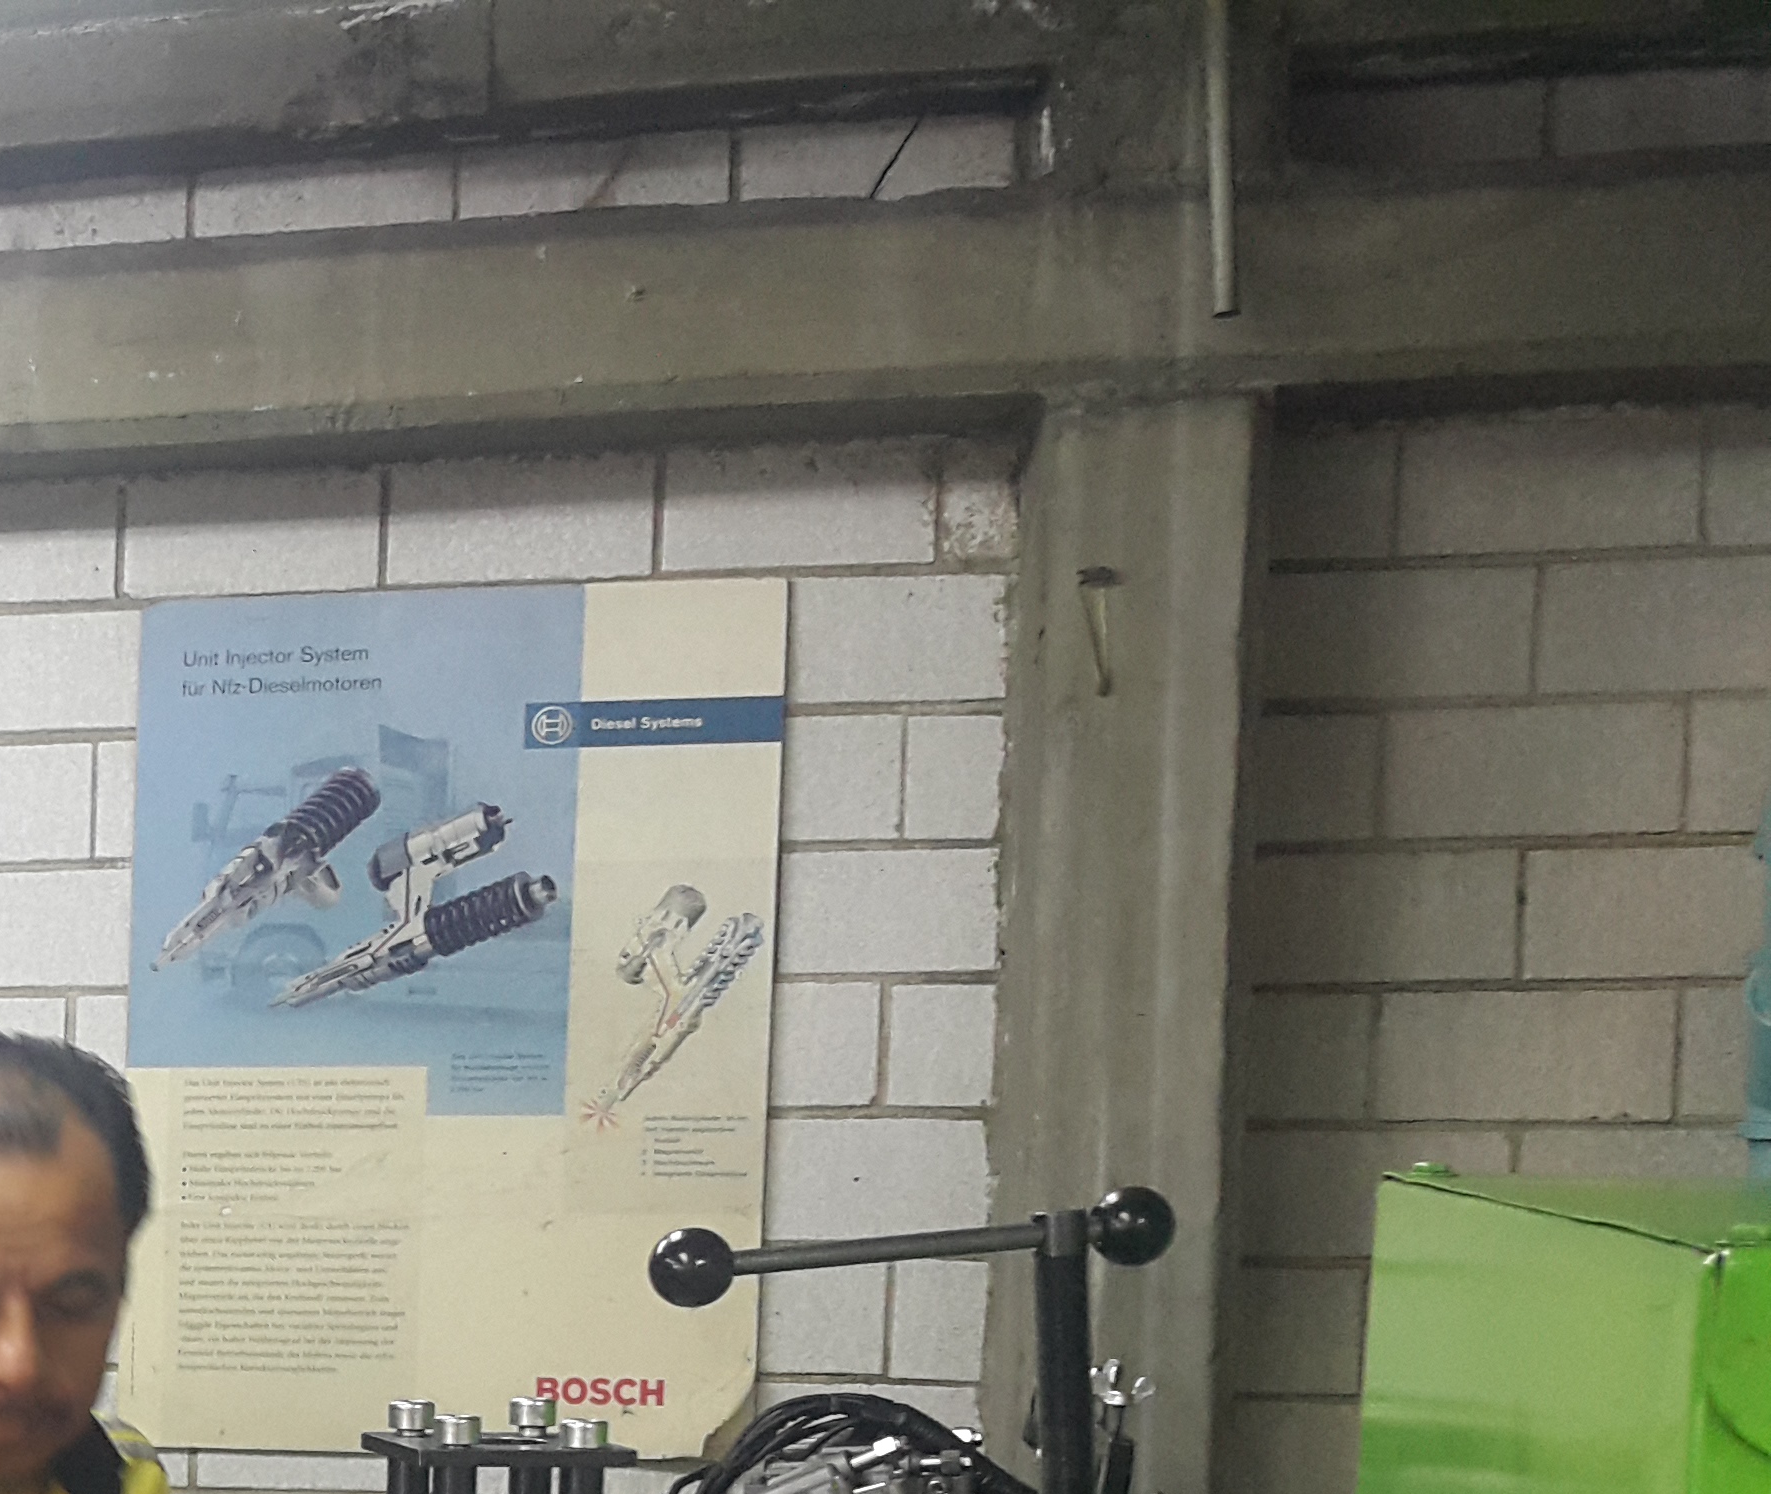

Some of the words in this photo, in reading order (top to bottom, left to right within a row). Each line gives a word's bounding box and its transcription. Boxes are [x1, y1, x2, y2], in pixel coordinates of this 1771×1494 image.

[182, 649, 219, 668] Unit
[225, 648, 294, 670] Injector
[299, 645, 370, 667] System
[181, 677, 206, 698] für
[211, 675, 383, 697] Nfz-Dieselmotoren
[590, 717, 637, 731] Diesel
[639, 716, 704, 732] Systems
[535, 1376, 666, 1407] BOSCH
